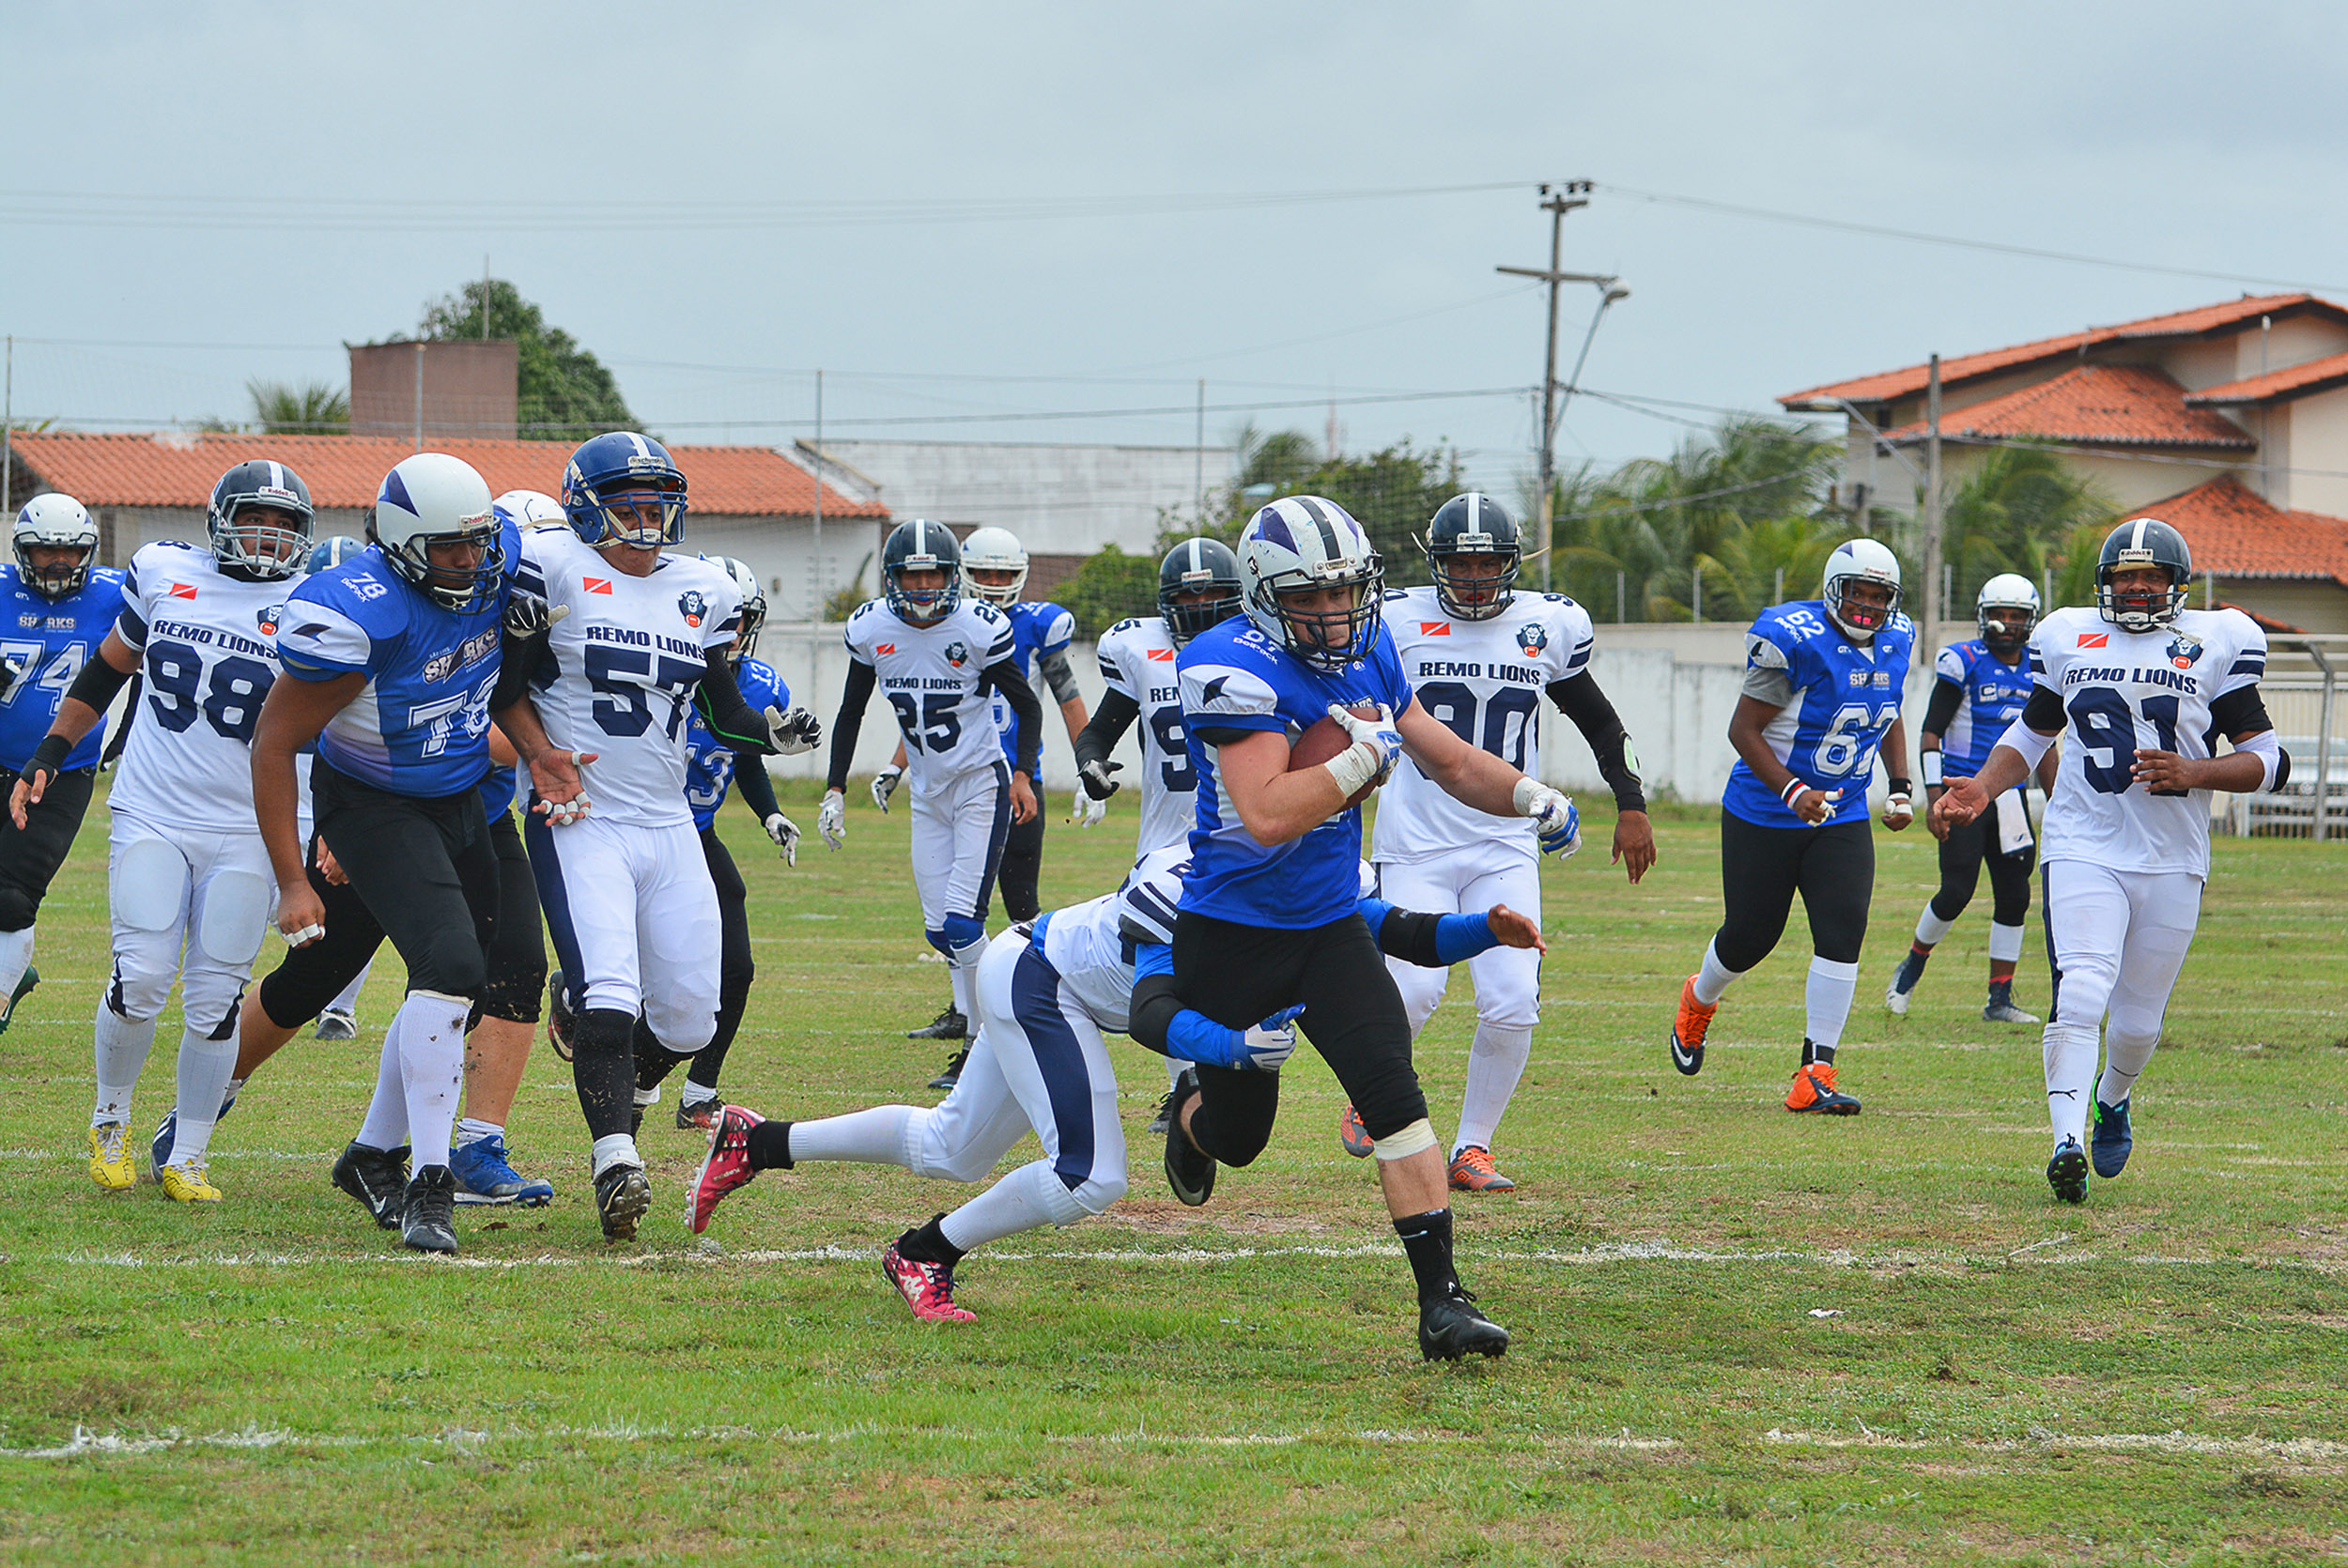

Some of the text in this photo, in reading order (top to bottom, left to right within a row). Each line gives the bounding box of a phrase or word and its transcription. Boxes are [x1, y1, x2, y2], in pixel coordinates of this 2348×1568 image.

[349, 572, 388, 598] 78
[153, 620, 278, 659] REMO LIONS
[586, 626, 706, 661] REMO LIONS
[1786, 610, 1825, 638] 62
[1233, 637, 1278, 665] DolPack
[0, 638, 88, 716] 74
[146, 639, 280, 744] 98
[750, 661, 772, 687] 13
[885, 677, 962, 690] REMO LIONS
[1419, 662, 1540, 684] REMO LIONS
[2065, 668, 2198, 695] REMO LIONS
[407, 666, 500, 758] 78
[584, 644, 707, 744] 57
[887, 693, 965, 757] 25
[1412, 681, 1539, 781] 90
[1811, 701, 1900, 779] 62
[2066, 686, 2188, 797] 91
